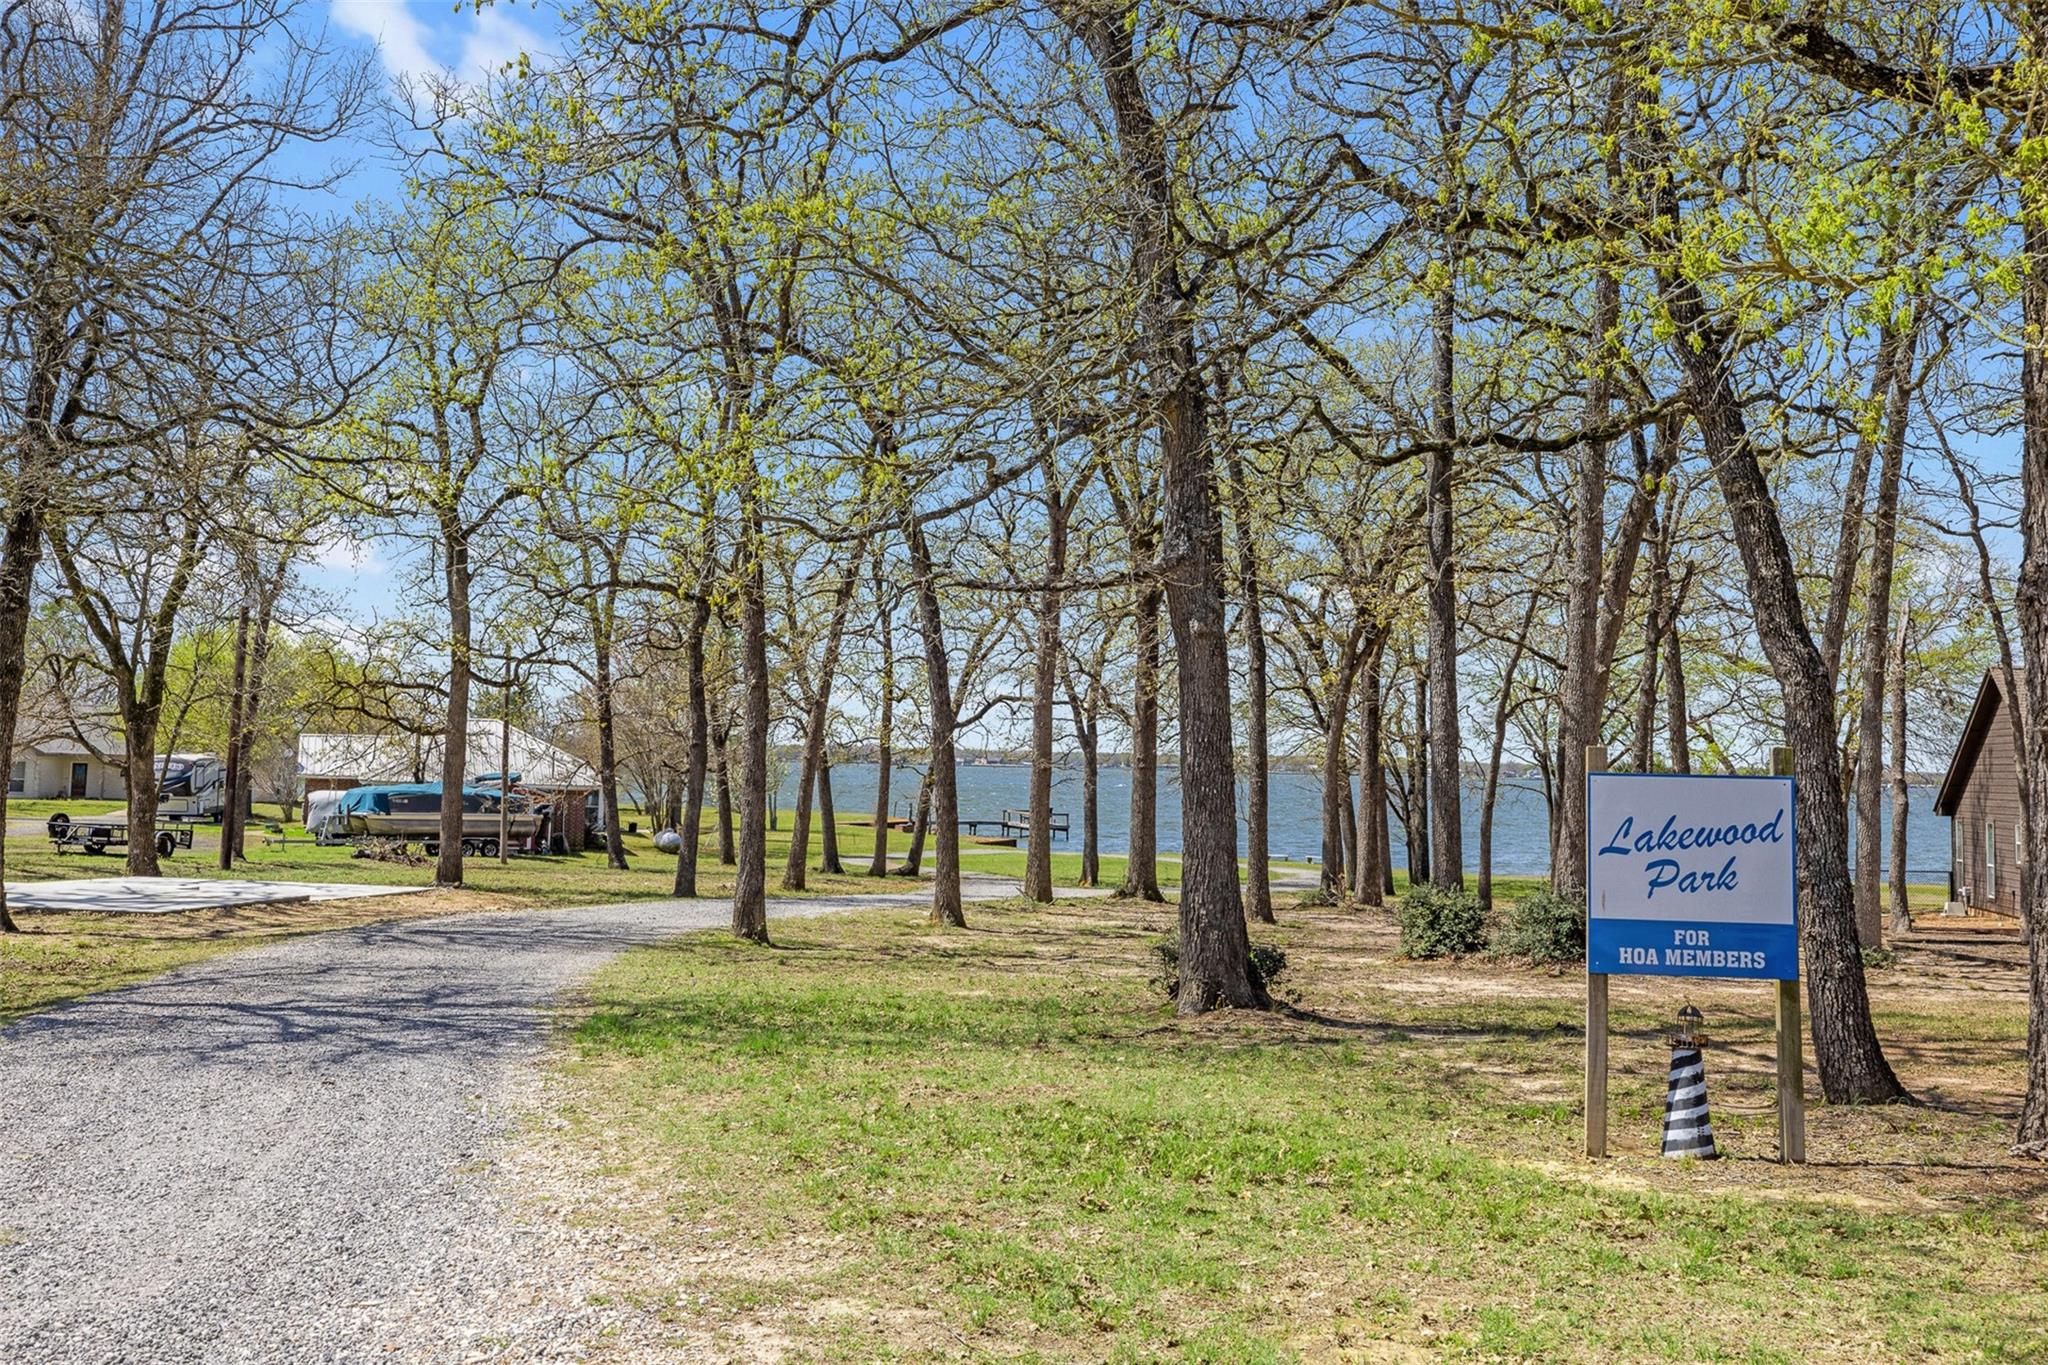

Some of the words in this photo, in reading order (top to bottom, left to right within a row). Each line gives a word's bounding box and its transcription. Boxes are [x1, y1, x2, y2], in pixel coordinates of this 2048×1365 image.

[1598, 808, 1785, 856] Lakewood
[1645, 856, 1740, 899] Park
[1674, 929, 1710, 946] FOR
[1619, 947, 1659, 965] HOA
[1665, 949, 1766, 969] MEMBERS
